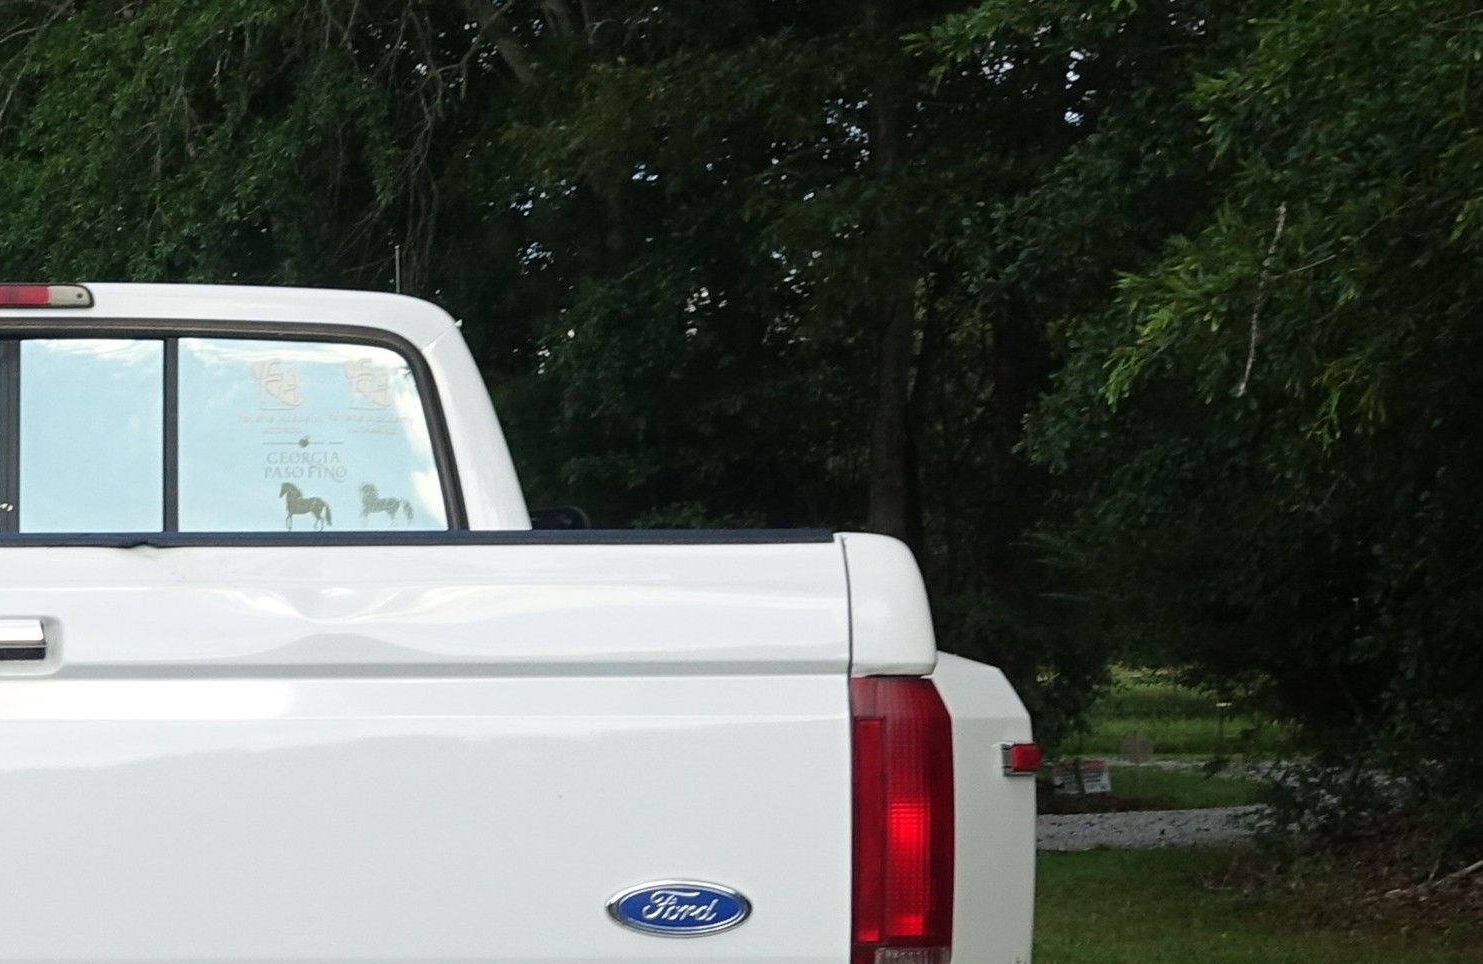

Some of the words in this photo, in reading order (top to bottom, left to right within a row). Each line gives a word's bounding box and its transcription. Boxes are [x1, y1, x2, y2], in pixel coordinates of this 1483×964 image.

[267, 451, 340, 465] GEORGIA
[265, 466, 304, 480] PASO
[307, 464, 348, 483] FINO
[642, 890, 720, 922] Ford
